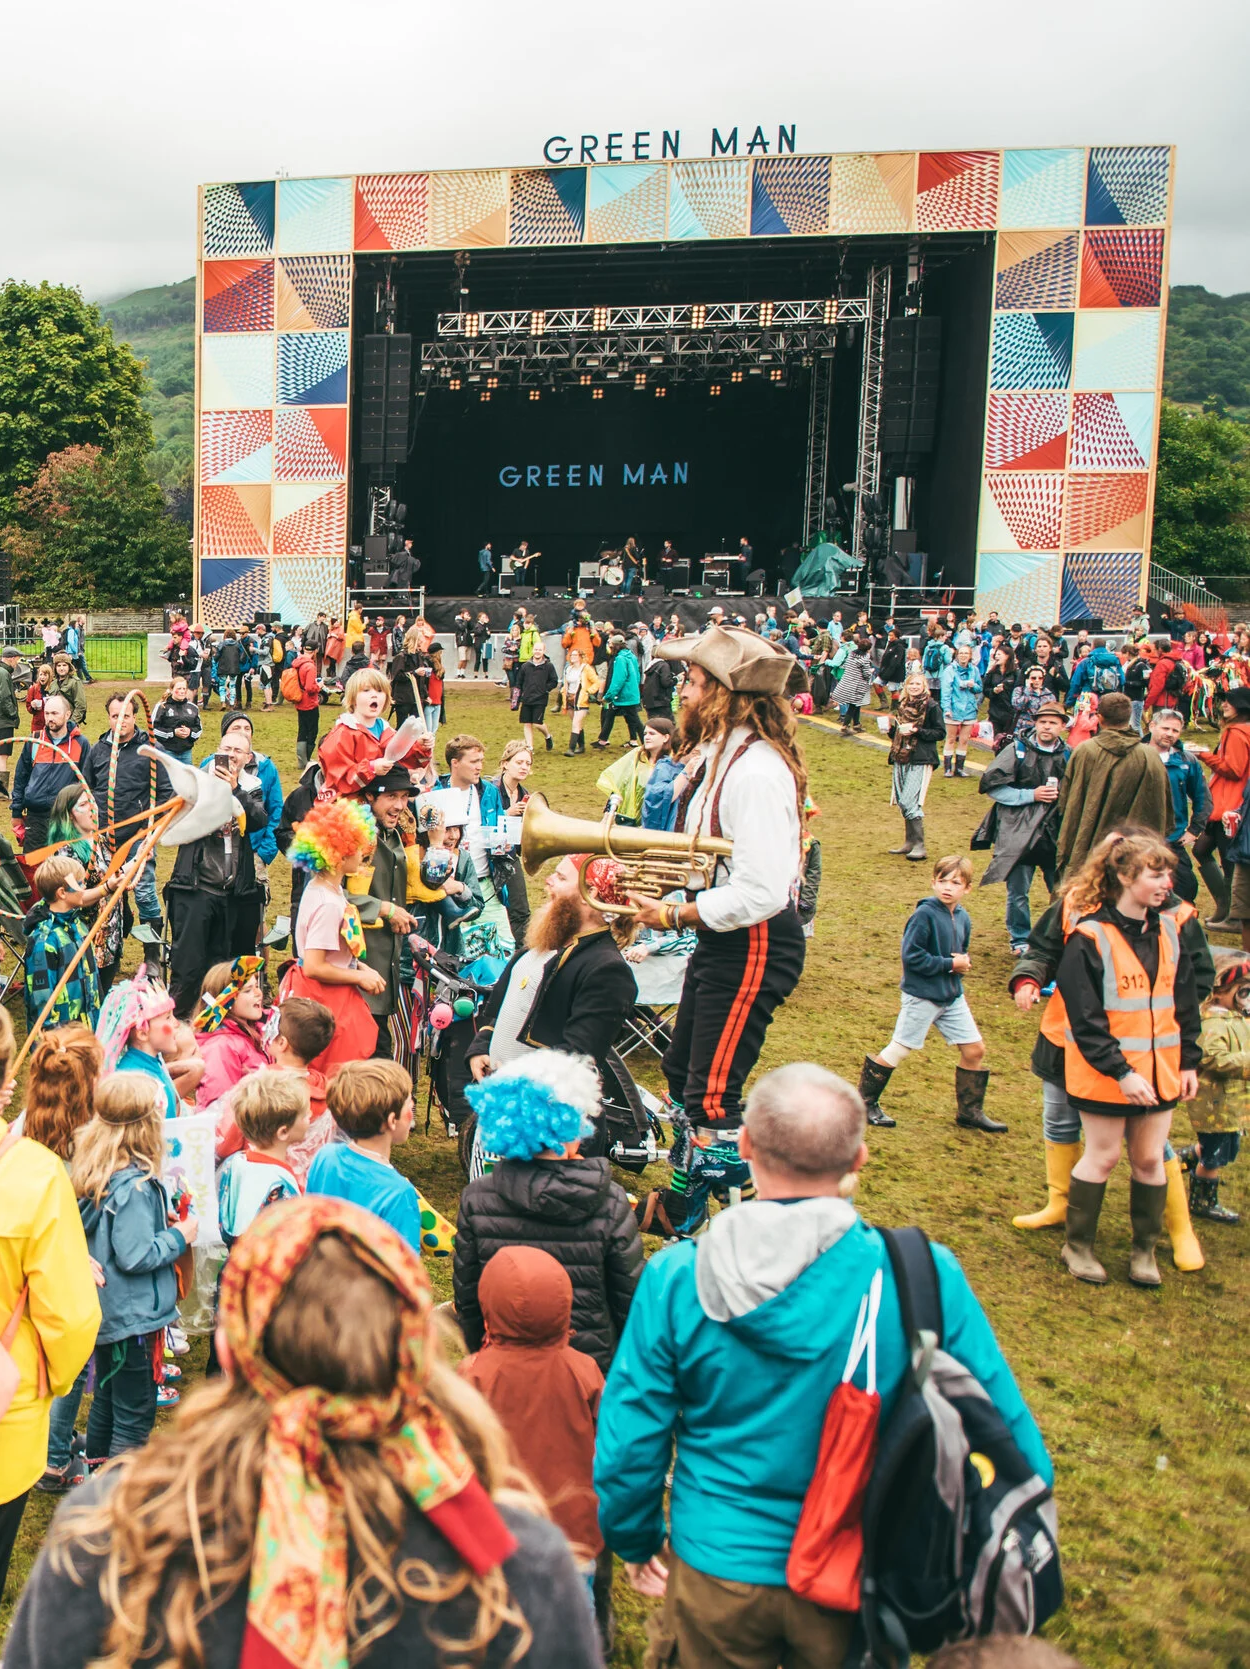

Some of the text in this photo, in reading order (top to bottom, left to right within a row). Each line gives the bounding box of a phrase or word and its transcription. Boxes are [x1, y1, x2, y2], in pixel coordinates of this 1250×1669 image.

[544, 124, 796, 163] GREEN MAN
[499, 462, 688, 487] GREEN MAN
